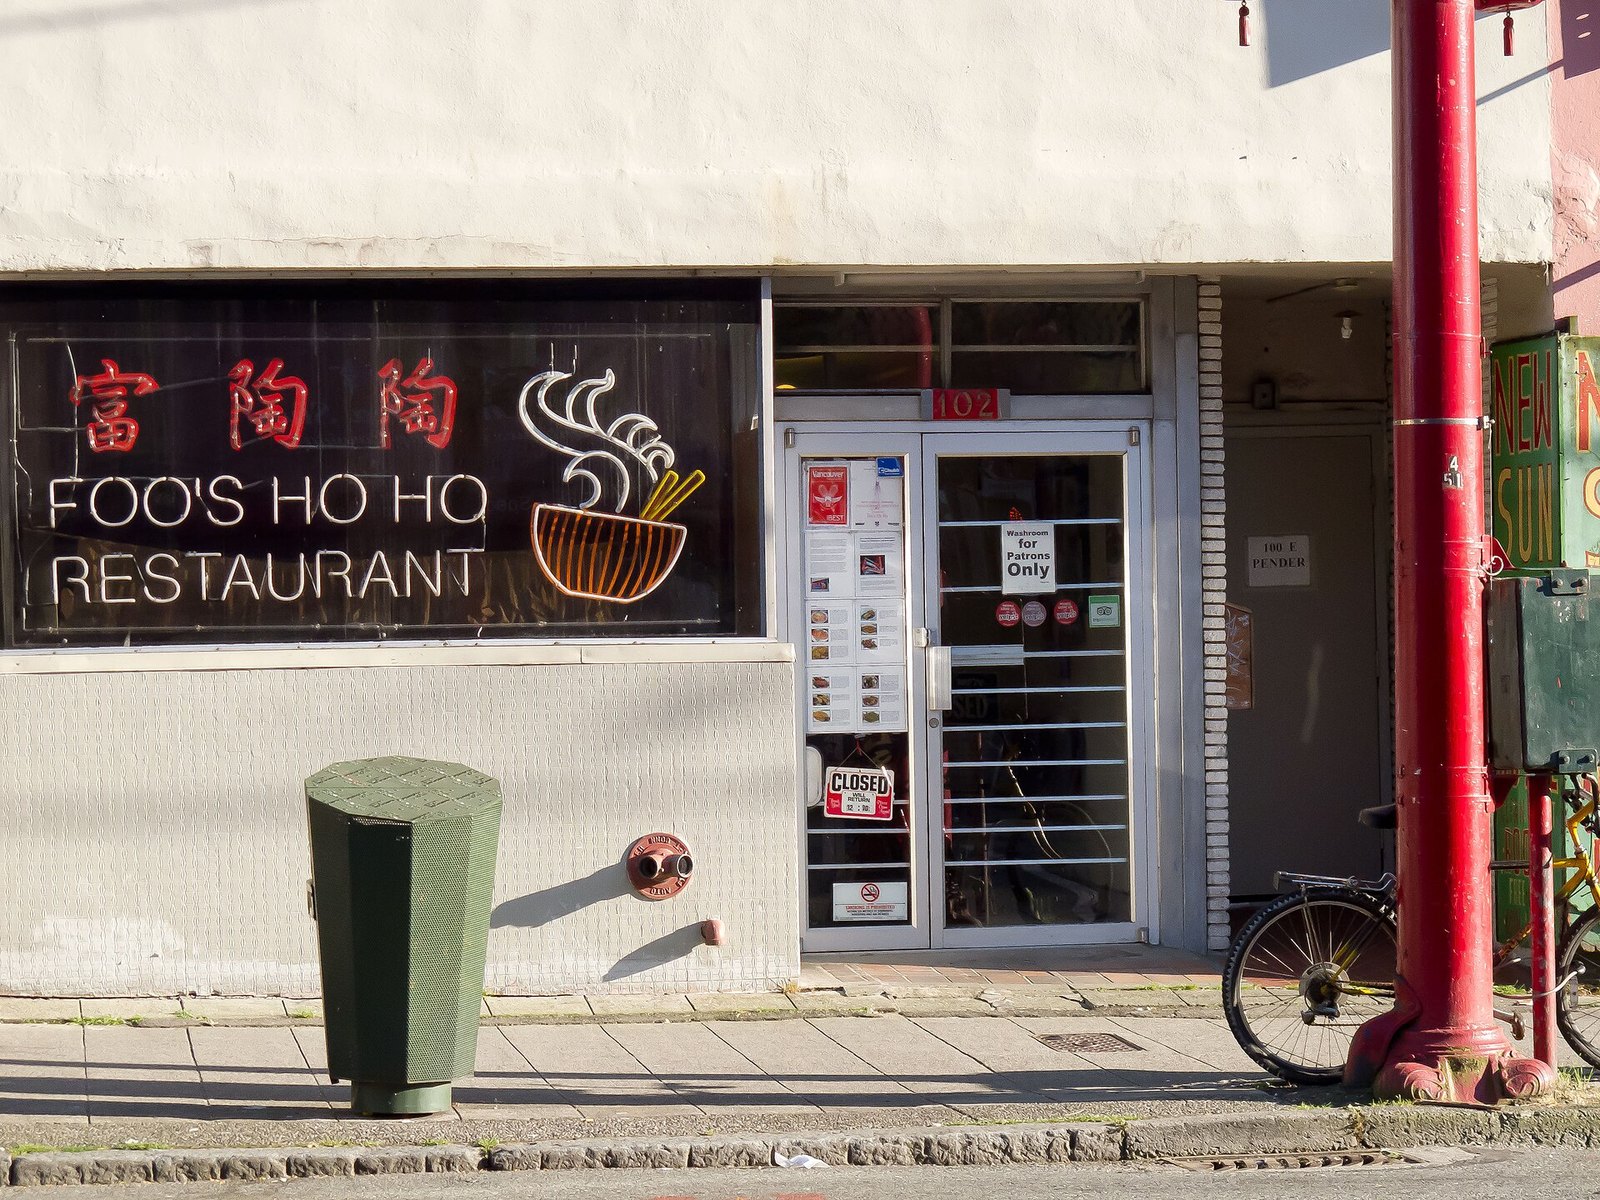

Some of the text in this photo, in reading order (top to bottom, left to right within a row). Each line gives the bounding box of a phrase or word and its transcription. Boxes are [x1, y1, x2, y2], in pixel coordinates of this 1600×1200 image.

[939, 391, 993, 417] 102
[1494, 351, 1552, 456] NEW
[1450, 455, 1458, 471] 4
[812, 470, 844, 478] Vancouver
[50, 473, 487, 528] FOO'S HO HO
[1497, 463, 1553, 563] SUN
[1018, 538, 1038, 548] for
[1264, 541, 1297, 552] 100 E
[1007, 552, 1051, 560] Patrons
[1253, 557, 1306, 568] PENDER
[53, 550, 484, 604] RESTAURANT
[1007, 562, 1050, 579] Only
[831, 773, 889, 794] CLOSED
